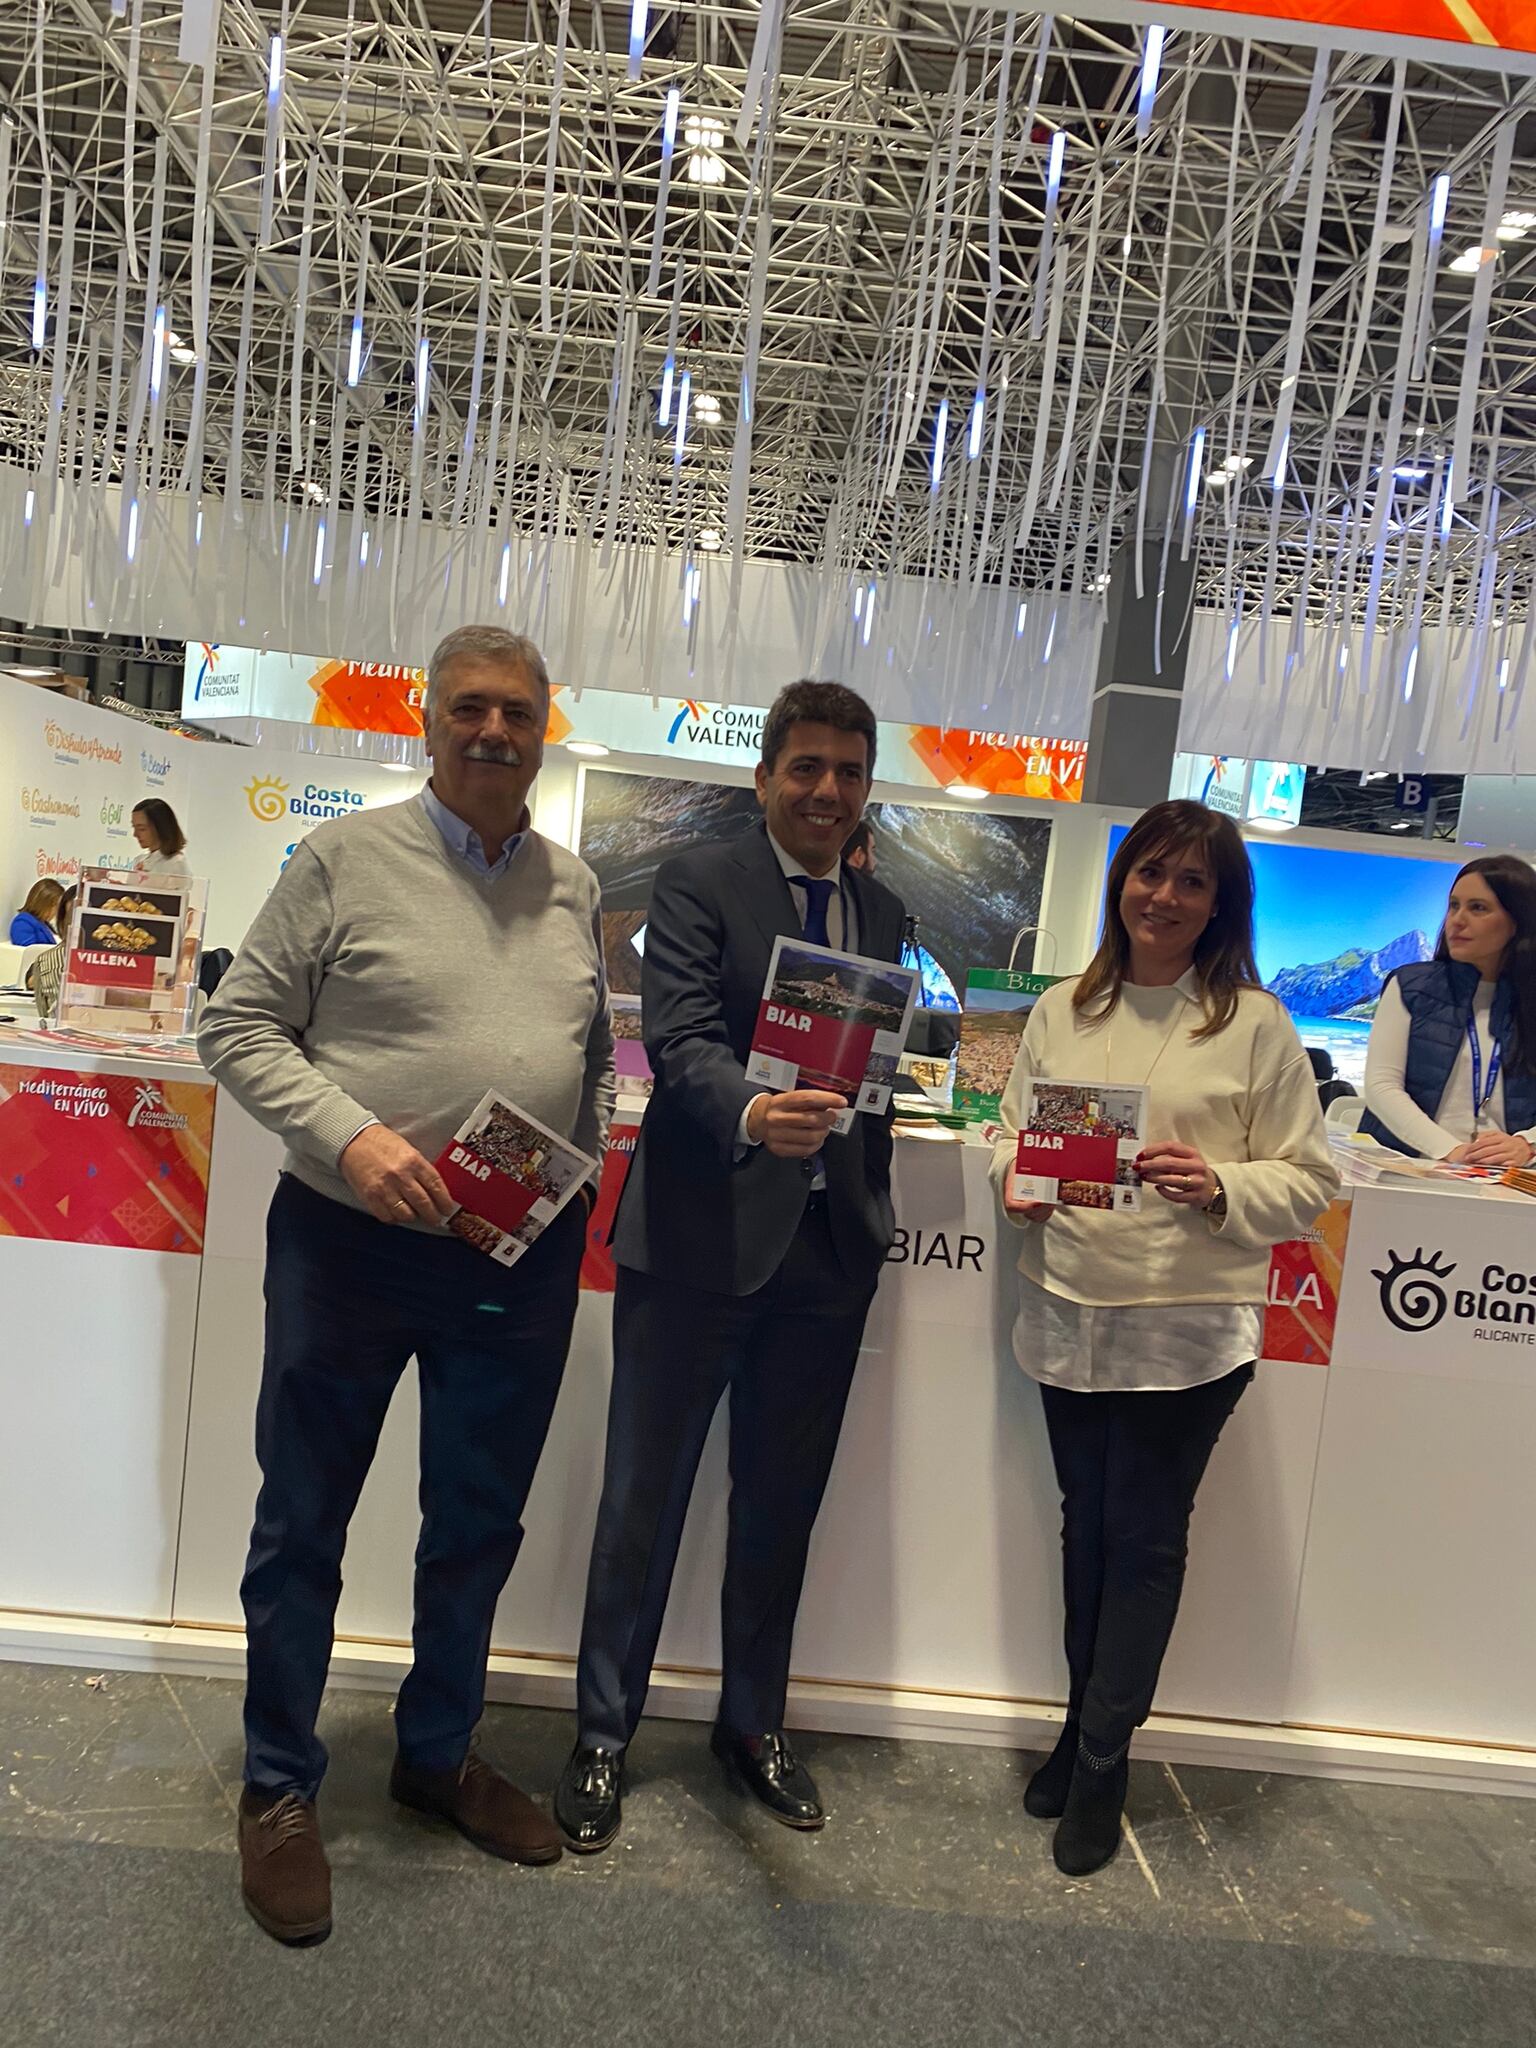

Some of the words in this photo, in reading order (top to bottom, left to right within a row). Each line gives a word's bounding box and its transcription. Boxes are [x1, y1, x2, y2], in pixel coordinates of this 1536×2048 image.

[203, 673, 240, 686] COMUNITAT
[202, 685, 240, 697] VALENCIANA
[687, 725, 763, 750] VALENC
[1026, 755, 1052, 776] EN
[304, 784, 363, 806] Costa
[1402, 780, 1422, 806] B
[289, 798, 361, 818] Blanc
[77, 952, 137, 968] VILLENA
[766, 1005, 812, 1033] BIAR
[19, 1080, 108, 1100] Mediterráneo
[54, 1099, 70, 1112] EN
[138, 1118, 188, 1129] VALENCIANA
[140, 1110, 189, 1122] COMUNITAT
[1023, 1133, 1064, 1150] BIAR
[448, 1146, 492, 1181] BIAR
[885, 1227, 985, 1272] BIAR
[1454, 1290, 1536, 1325] Blan
[1473, 1328, 1536, 1345] ALICANTE
